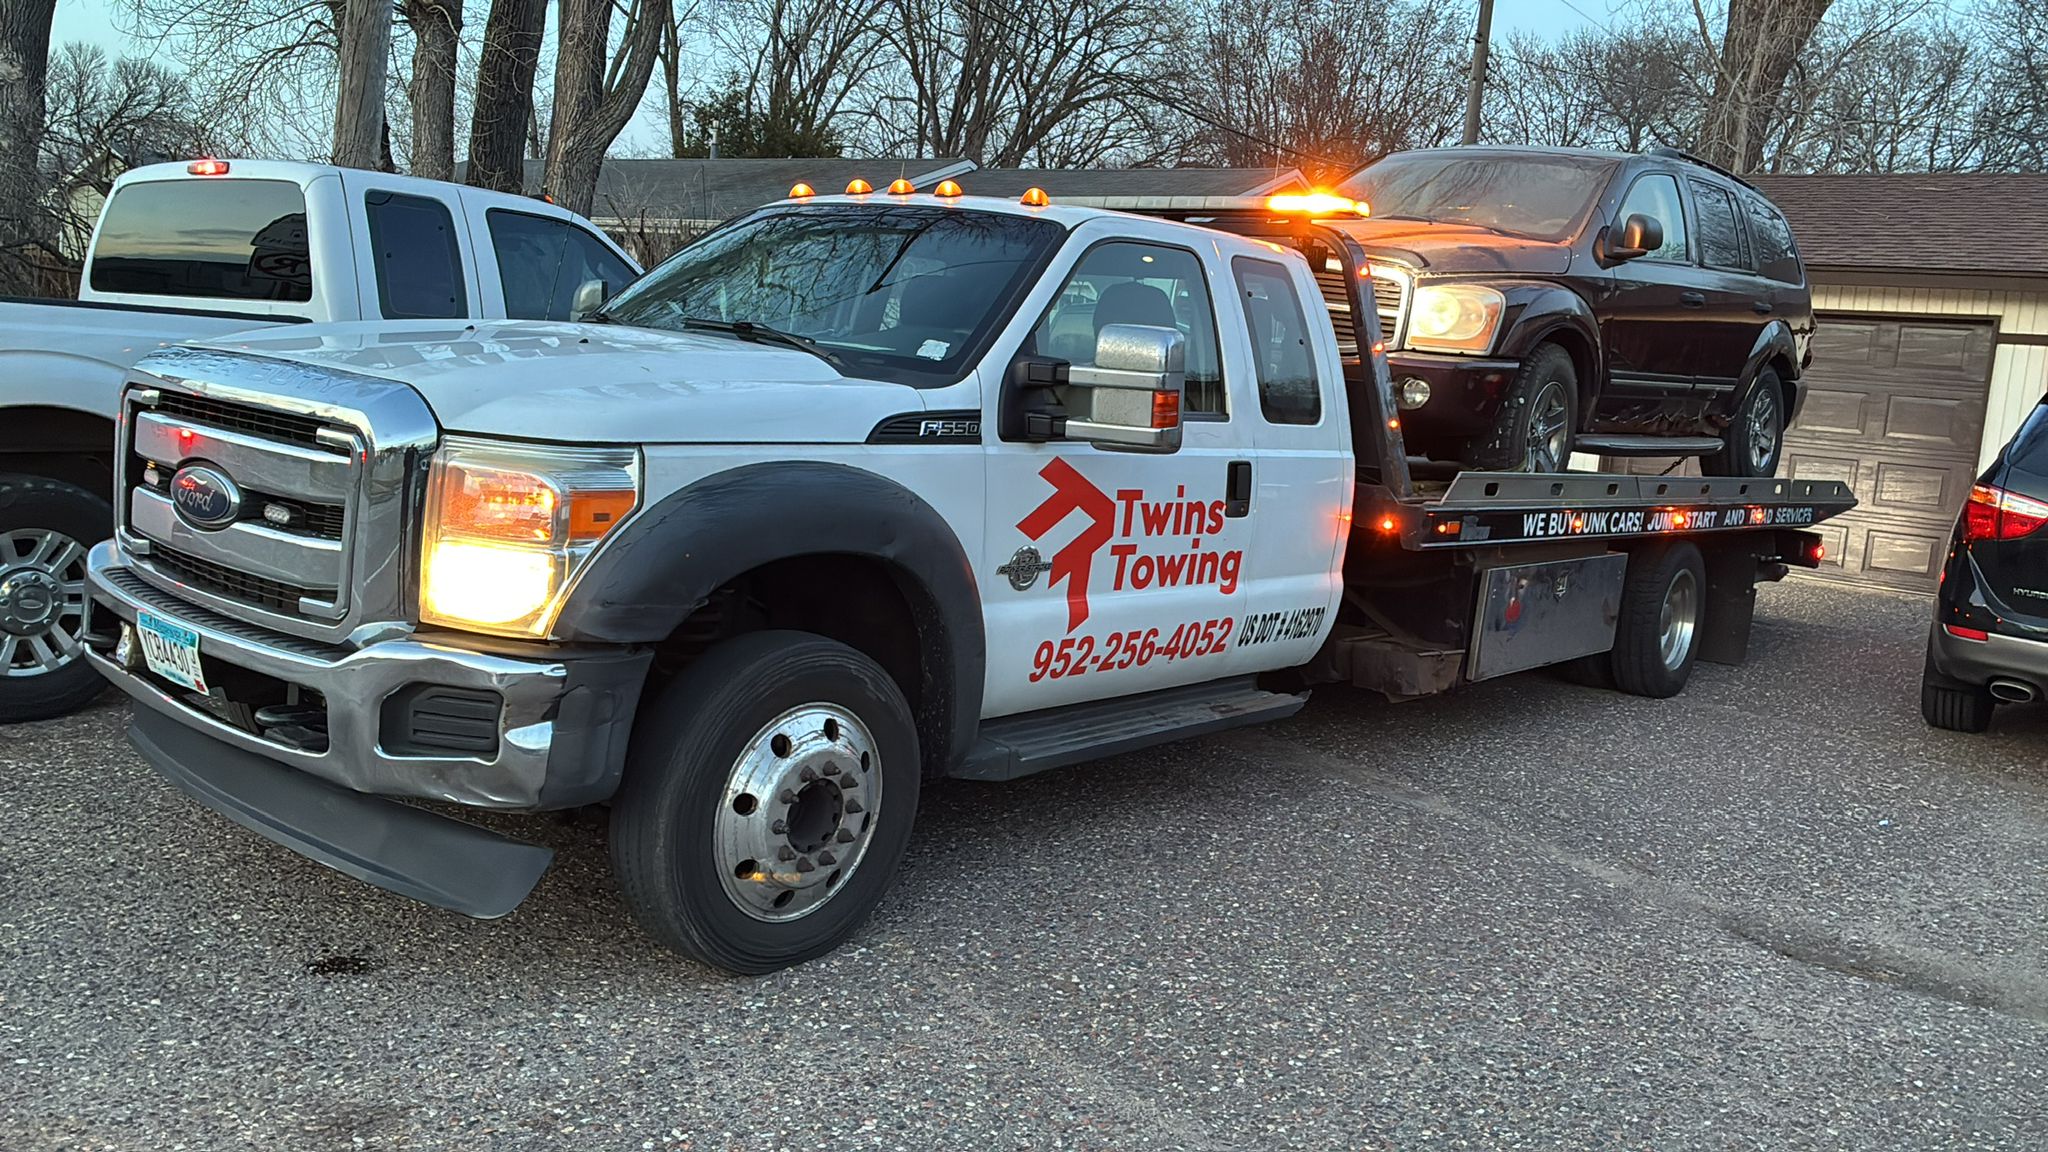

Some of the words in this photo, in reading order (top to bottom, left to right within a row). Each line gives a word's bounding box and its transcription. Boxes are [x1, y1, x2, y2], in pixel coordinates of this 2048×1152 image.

[177, 474, 216, 512] Ford
[1116, 485, 1226, 538] Twins
[1523, 512, 1547, 537] WE
[1548, 512, 1576, 535] BUY
[1575, 511, 1611, 534] JUNK
[1610, 511, 1645, 533] CARS!
[1684, 511, 1718, 529] START
[1723, 509, 1745, 526] AND
[1749, 508, 1773, 525] ROAD
[1110, 538, 1243, 595] Towing
[1028, 616, 1234, 683] 952-256-4052
[1237, 613, 1259, 648] US
[1252, 611, 1281, 645] DOT
